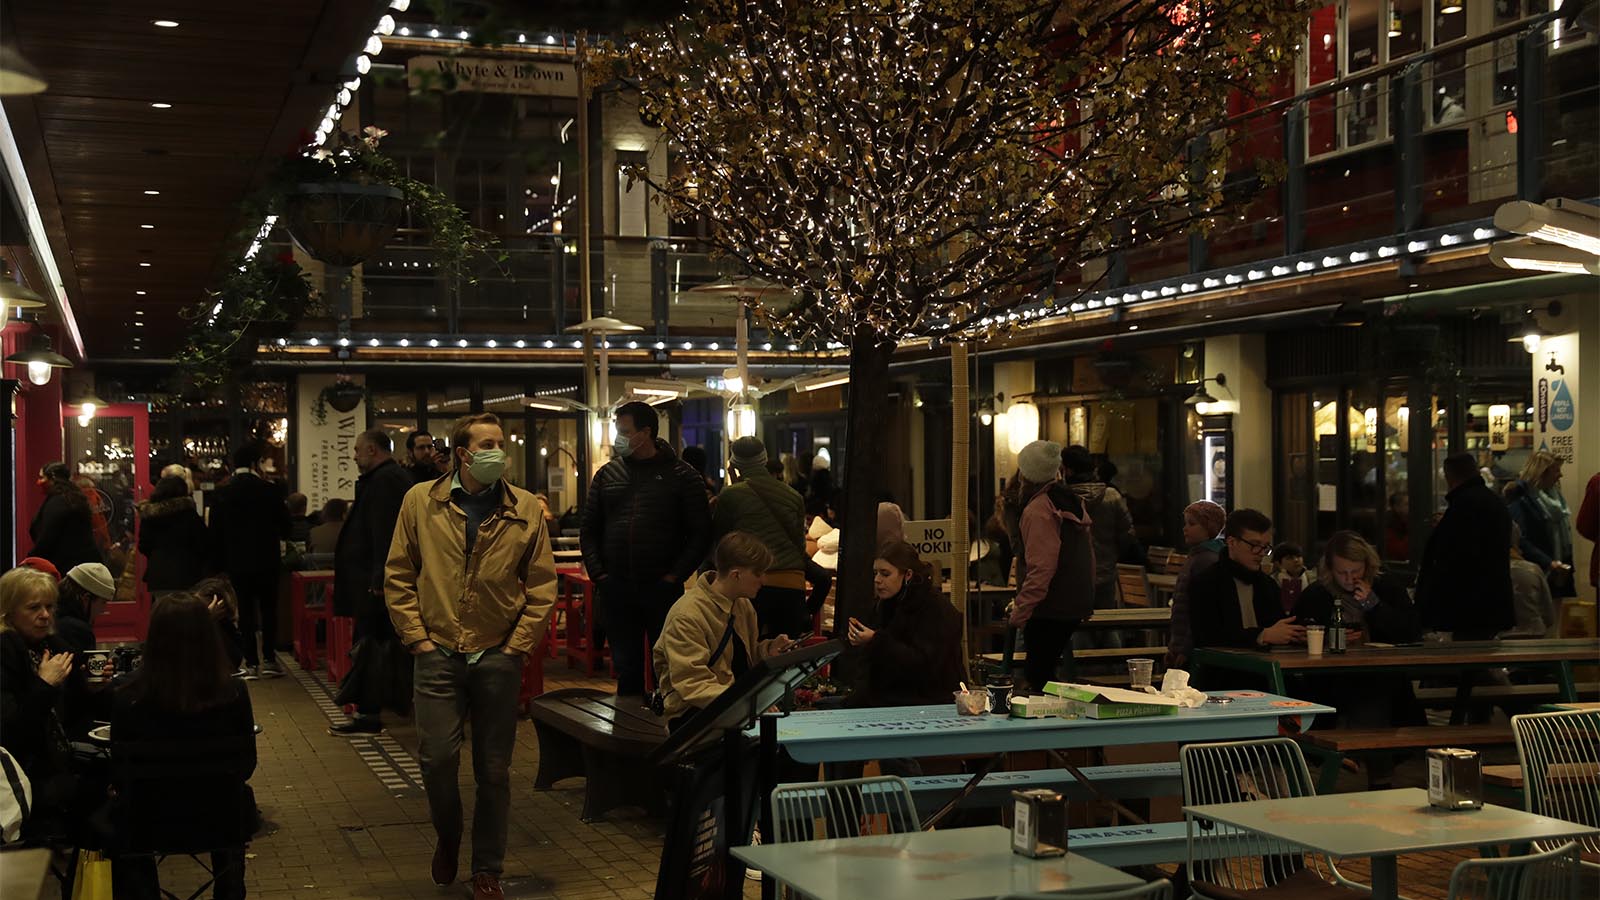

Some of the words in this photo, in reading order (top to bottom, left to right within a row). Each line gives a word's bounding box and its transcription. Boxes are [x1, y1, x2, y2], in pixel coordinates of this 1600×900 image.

[494, 64, 507, 79] &
[514, 65, 564, 80] Bown
[331, 416, 356, 473] Whyte
[1551, 435, 1574, 447] FREE
[337, 477, 354, 490] &
[924, 529, 944, 540] NO
[911, 541, 952, 553] MOKIN
